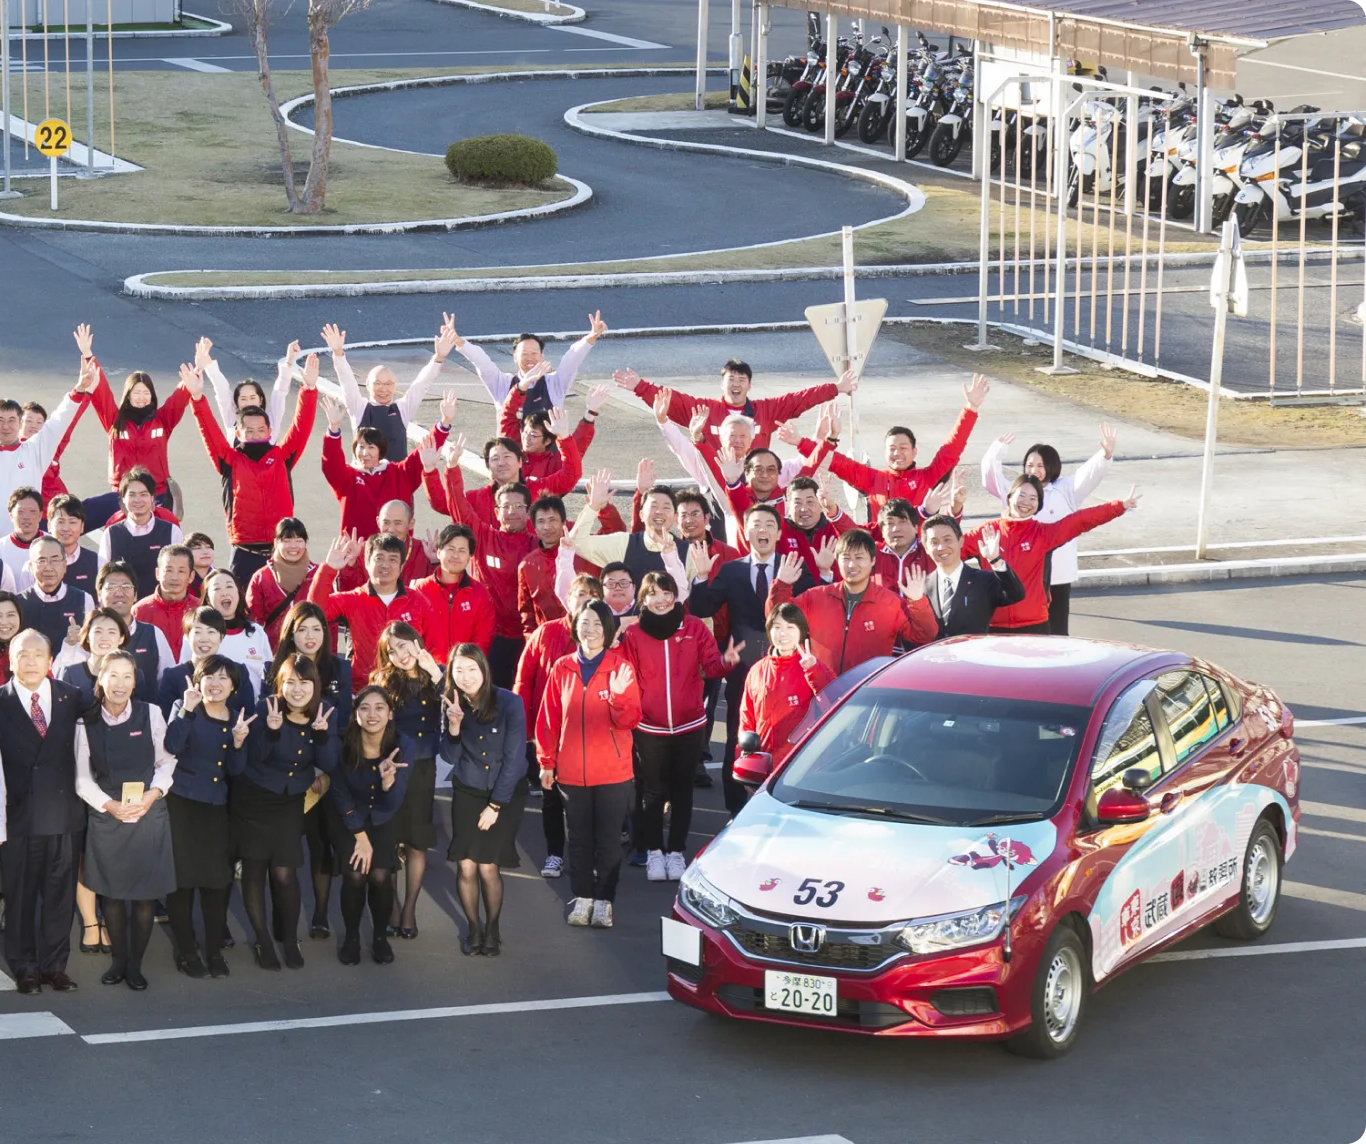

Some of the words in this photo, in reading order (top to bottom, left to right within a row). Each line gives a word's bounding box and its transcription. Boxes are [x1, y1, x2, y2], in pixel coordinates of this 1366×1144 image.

[40, 126, 67, 149] 22
[793, 878, 845, 908] 53
[783, 975, 802, 987] 多摩
[803, 978, 821, 990] 830
[770, 991, 778, 1001] と
[781, 988, 833, 1012] 20-20
